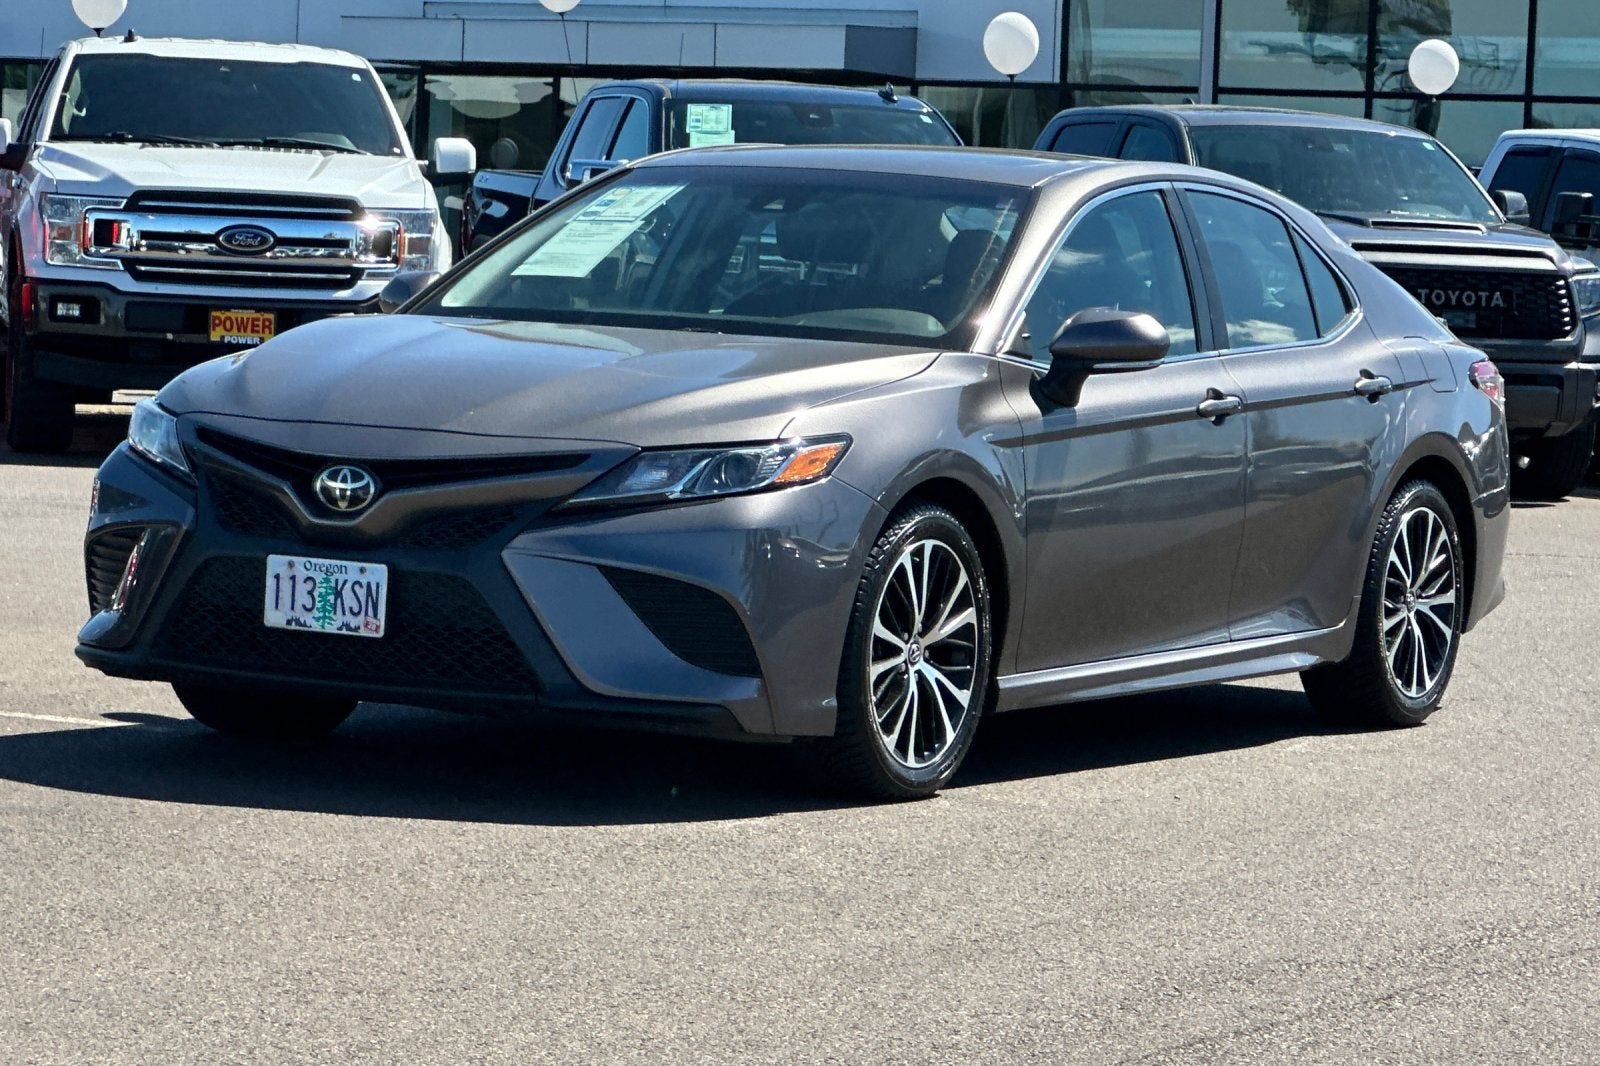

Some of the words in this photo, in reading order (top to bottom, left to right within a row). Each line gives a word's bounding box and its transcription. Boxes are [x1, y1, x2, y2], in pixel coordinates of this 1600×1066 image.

[232, 232, 261, 246] Ford
[1417, 289, 1504, 307] TOYOTA
[211, 315, 273, 335] POWER
[224, 335, 261, 345] POWER
[303, 560, 348, 576] Oregon
[273, 572, 317, 613] 113
[333, 578, 380, 619] KSN
